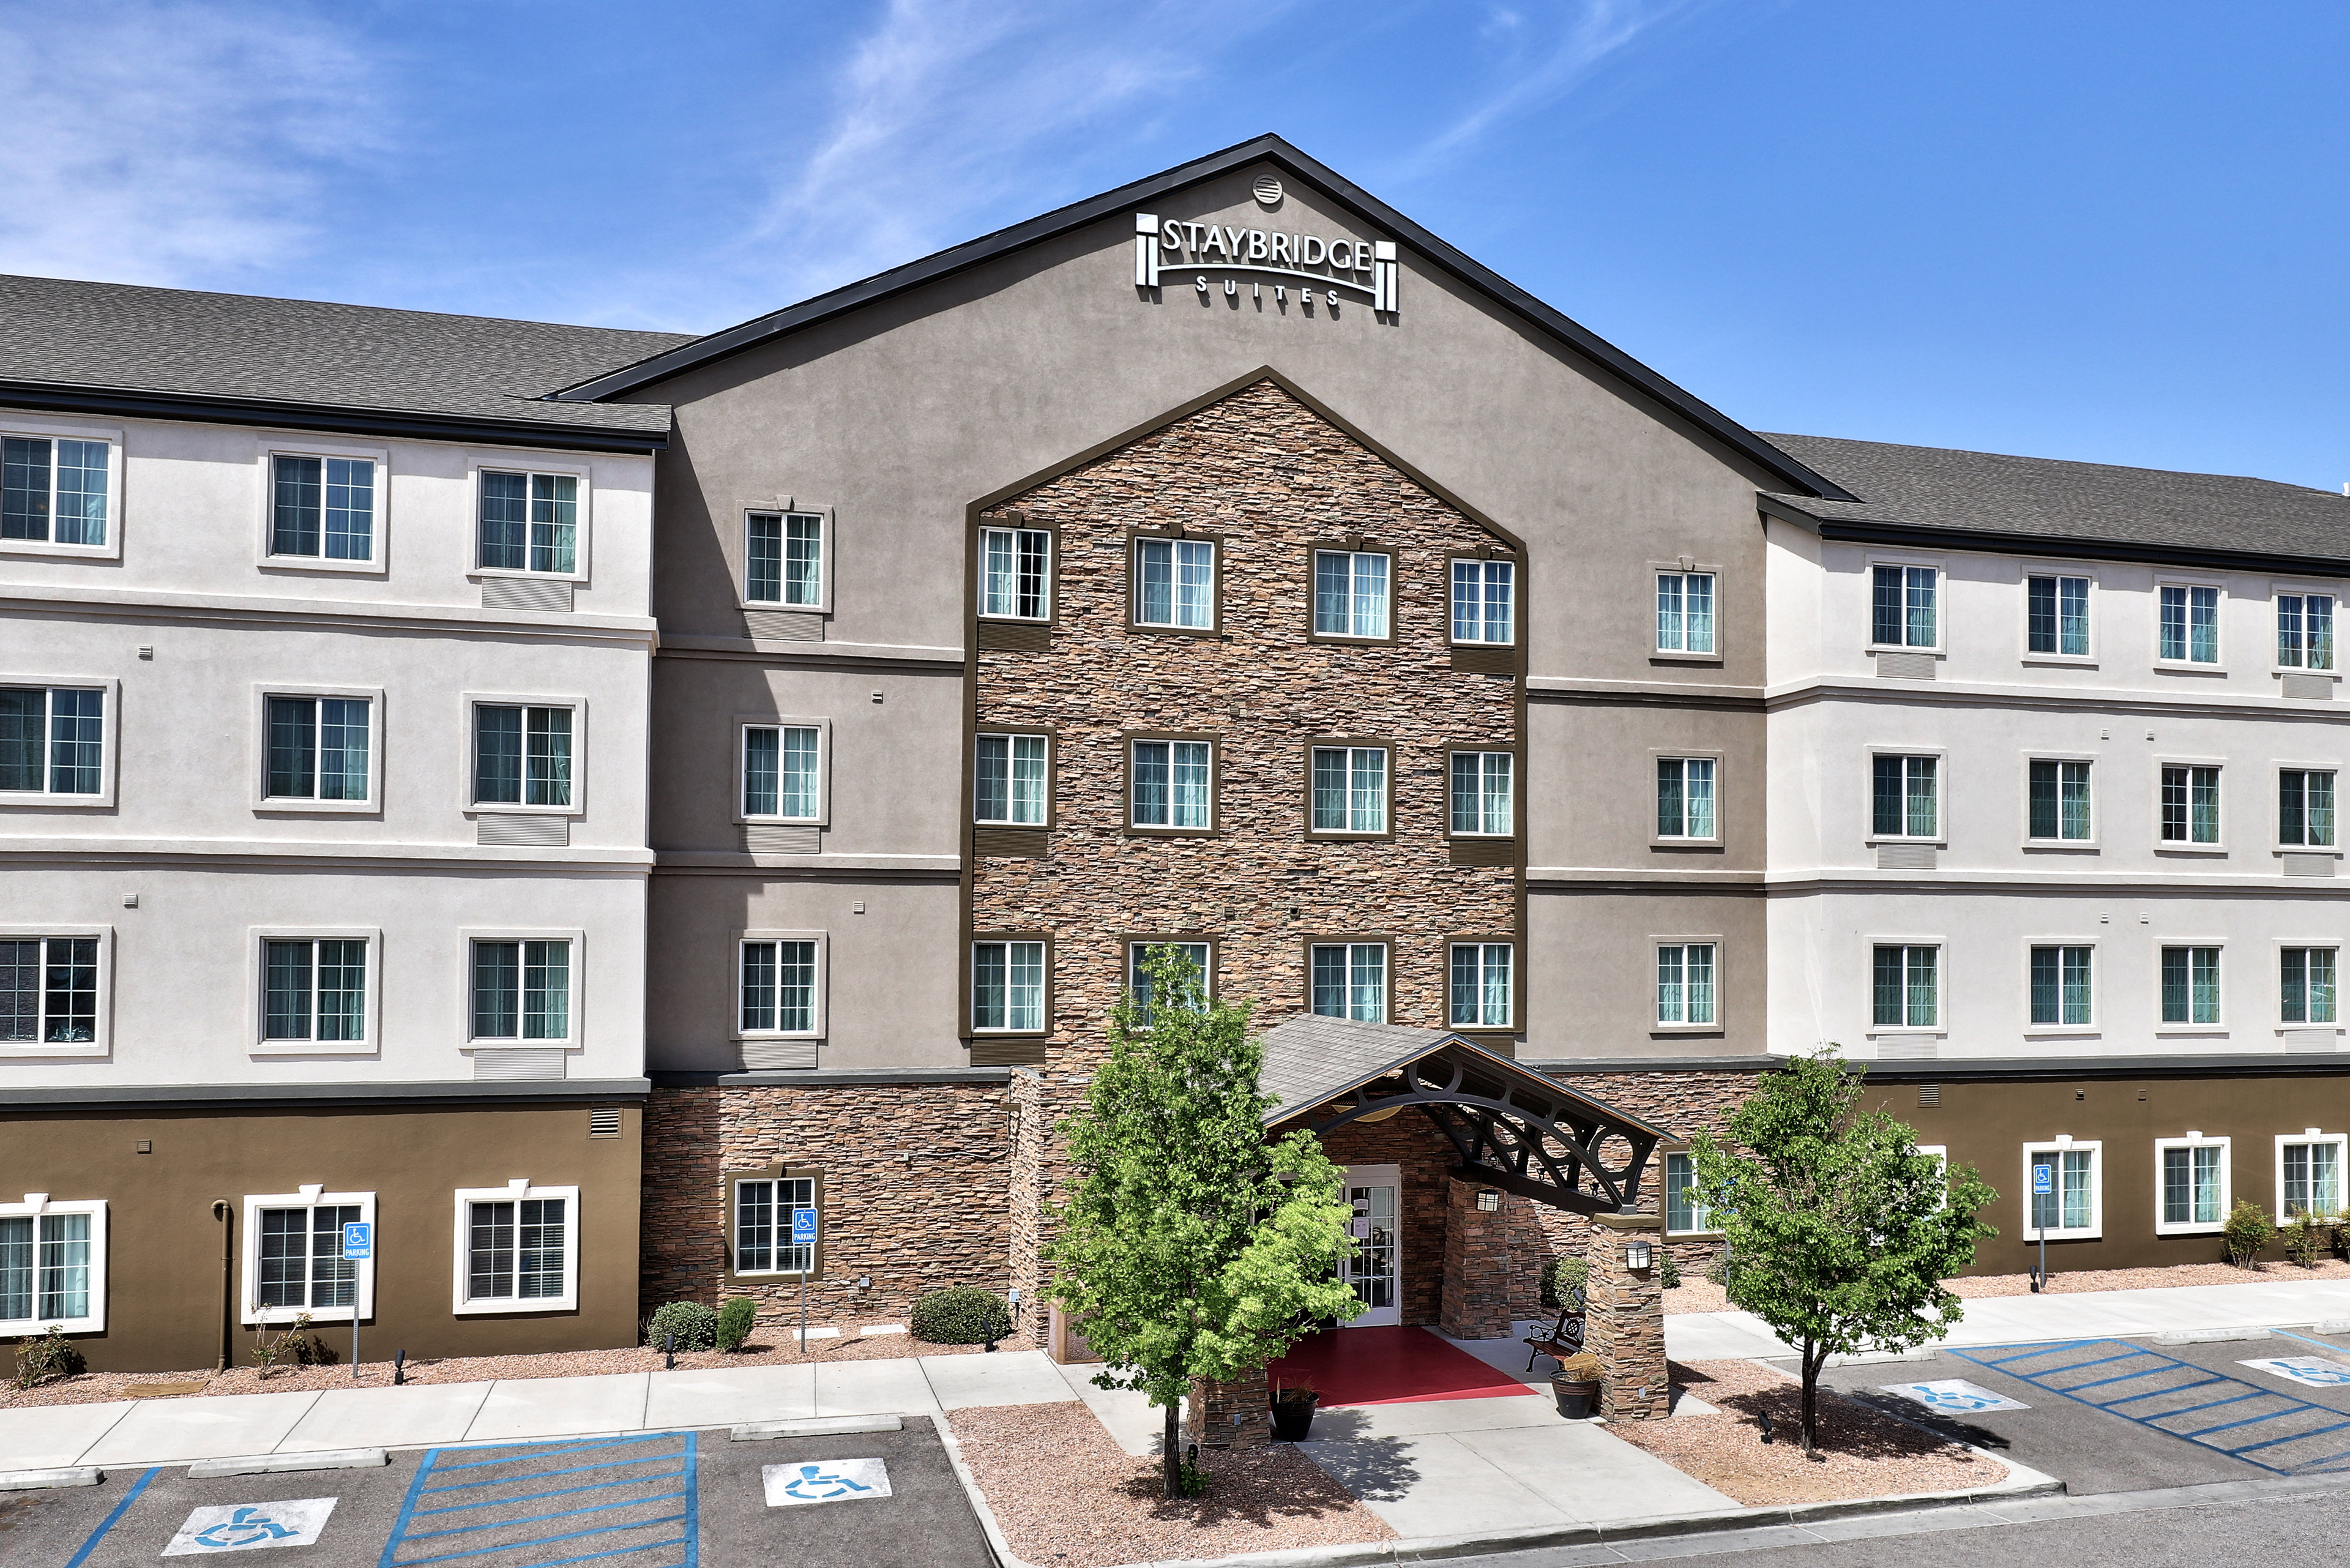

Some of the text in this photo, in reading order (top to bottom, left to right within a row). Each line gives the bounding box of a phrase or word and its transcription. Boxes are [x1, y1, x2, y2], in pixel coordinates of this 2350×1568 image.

[1163, 218, 1371, 271] STAYBRIDGE
[1195, 275, 1338, 306] SUITES
[345, 1248, 370, 1256] PARKING
